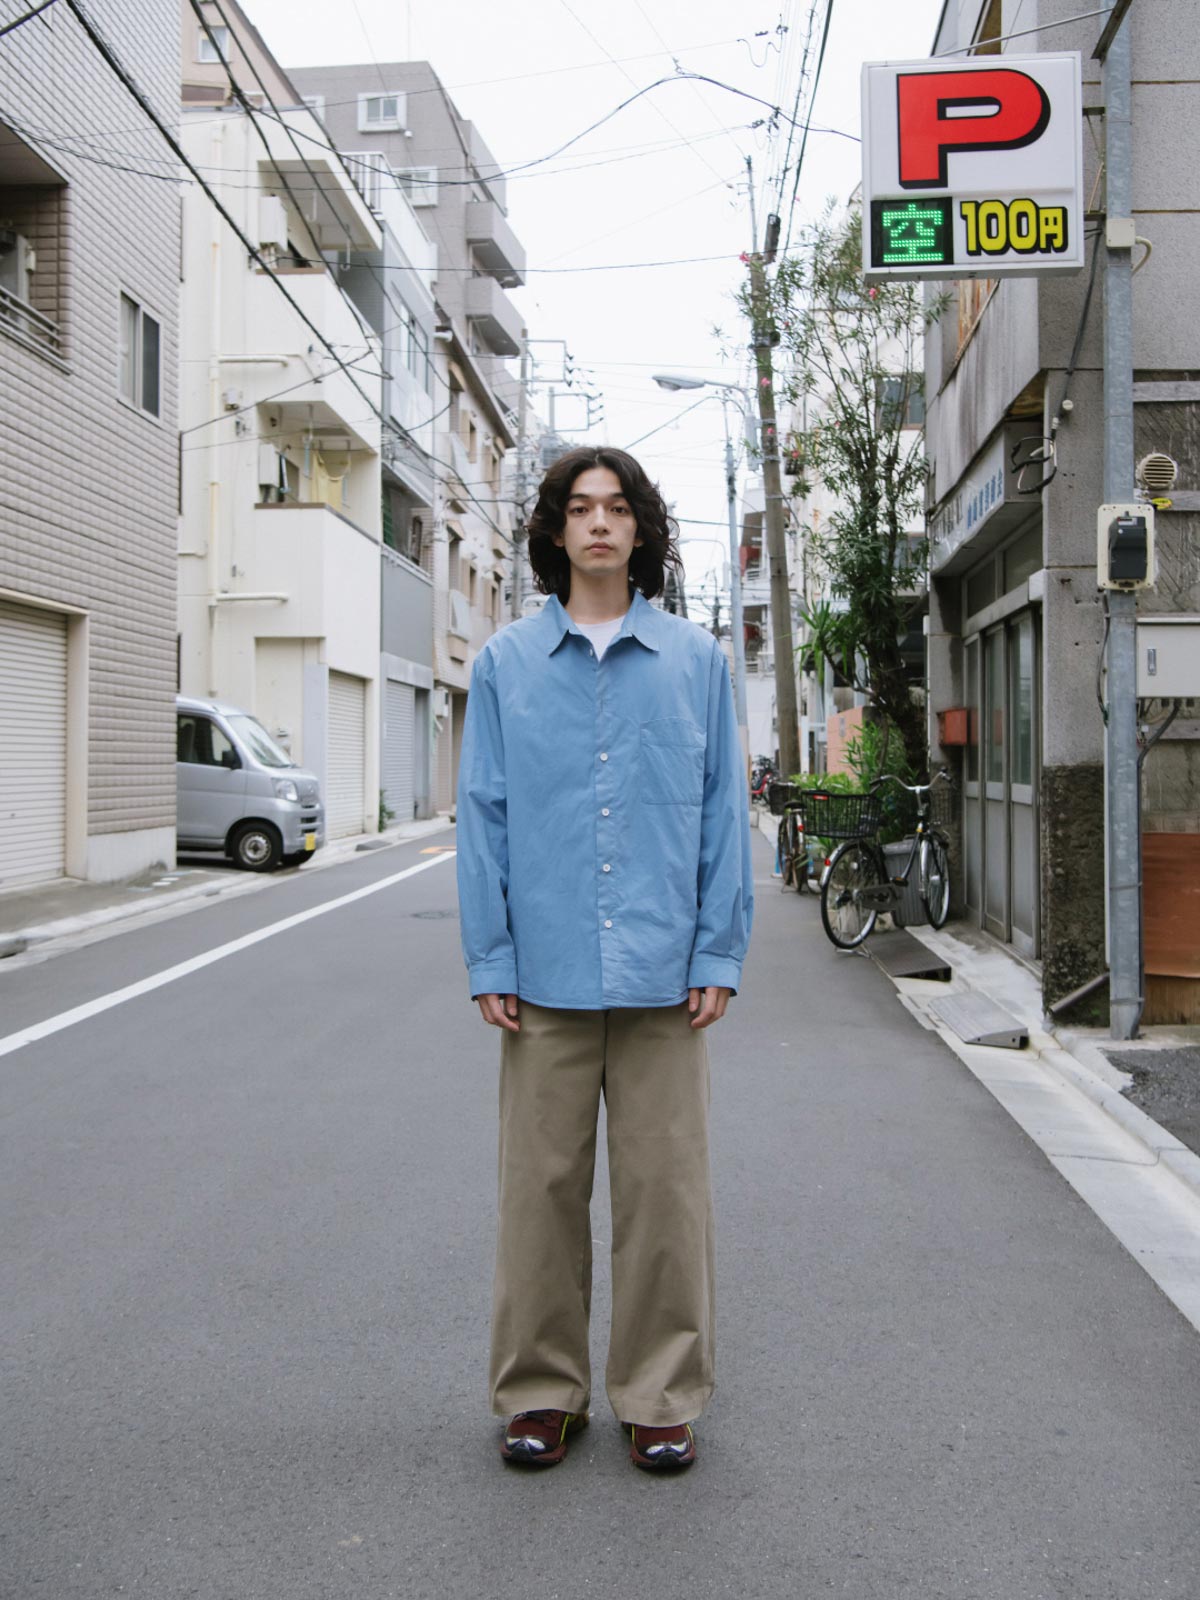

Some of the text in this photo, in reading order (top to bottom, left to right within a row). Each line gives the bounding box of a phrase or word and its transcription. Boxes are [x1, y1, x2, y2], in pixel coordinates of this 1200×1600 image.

[897, 68, 1051, 190] P
[882, 204, 944, 263] 空
[960, 198, 1068, 256] 100円
